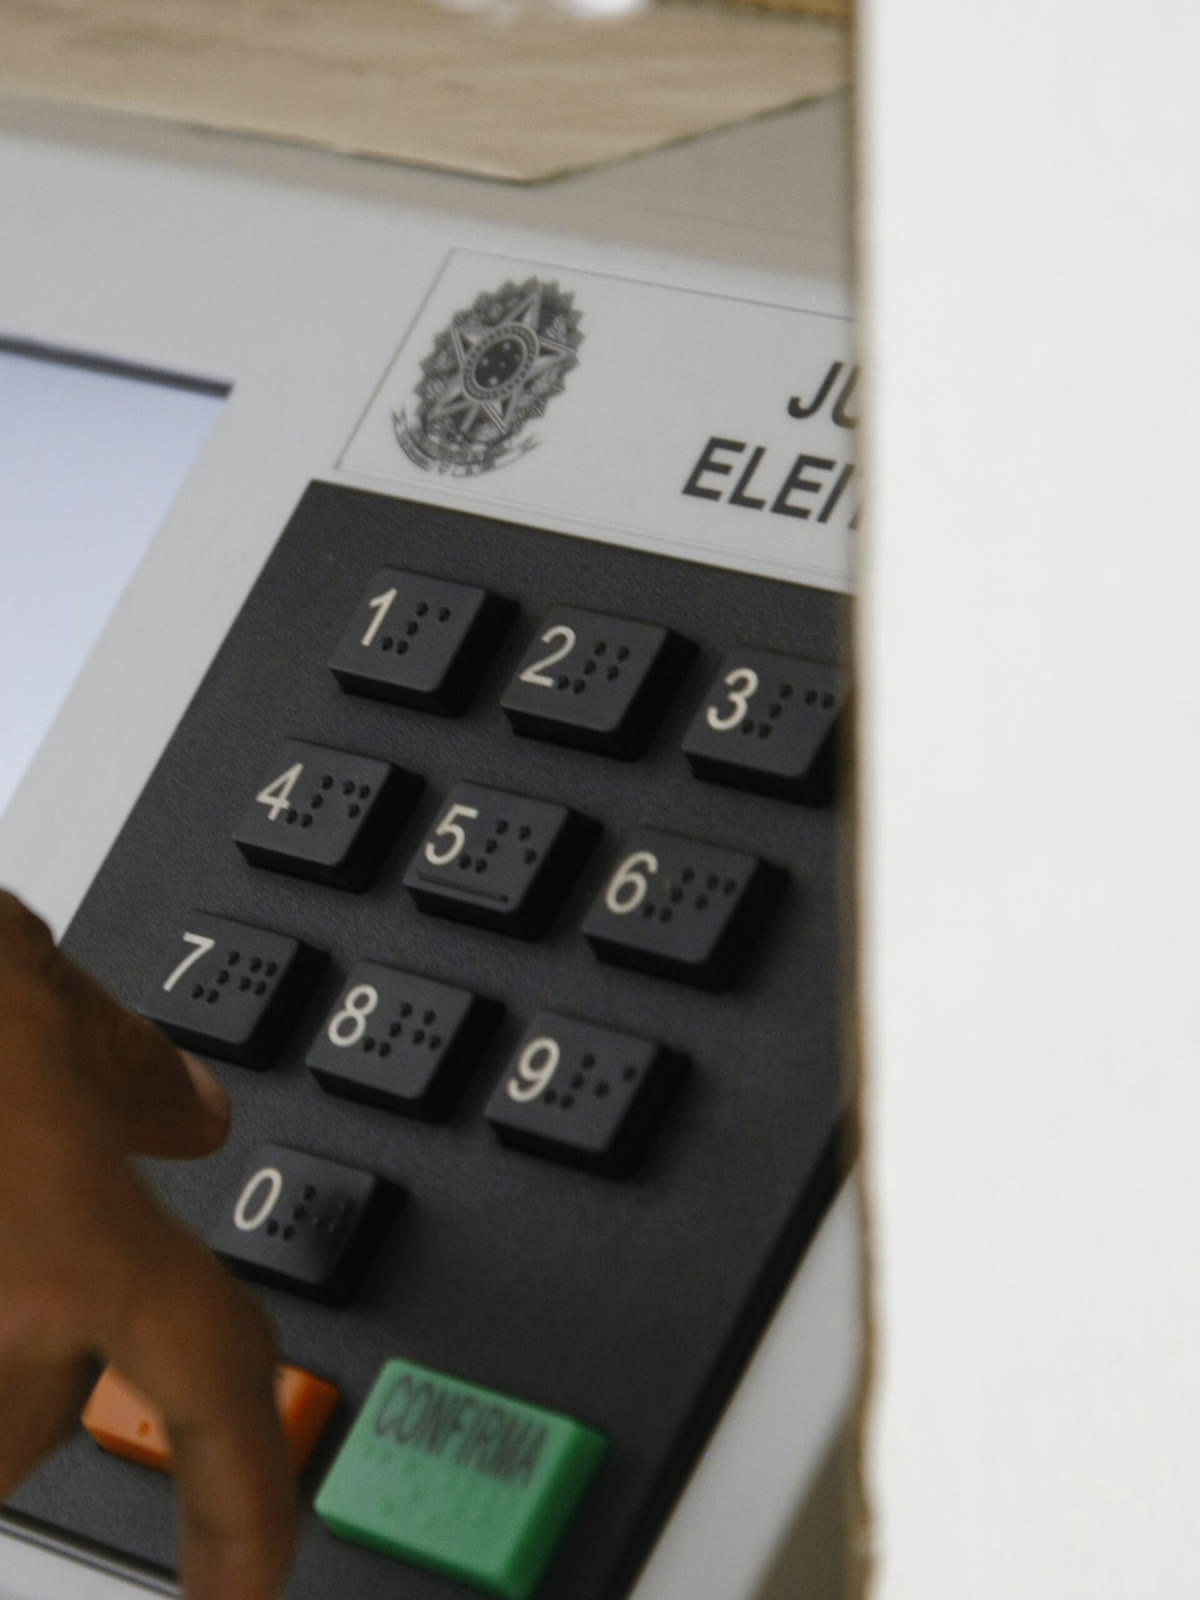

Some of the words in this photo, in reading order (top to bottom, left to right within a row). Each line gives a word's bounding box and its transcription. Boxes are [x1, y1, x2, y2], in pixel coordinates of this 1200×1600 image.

[361, 588, 398, 648] 1
[519, 625, 576, 688] 2
[706, 668, 760, 731] 3
[256, 763, 304, 821] 4
[424, 803, 479, 866] 5
[605, 852, 659, 914] 6
[162, 931, 215, 993] 7
[326, 984, 379, 1048] 8
[506, 1037, 561, 1103] 9
[233, 1166, 283, 1232] 0
[375, 1374, 549, 1489] CONFIRMA
